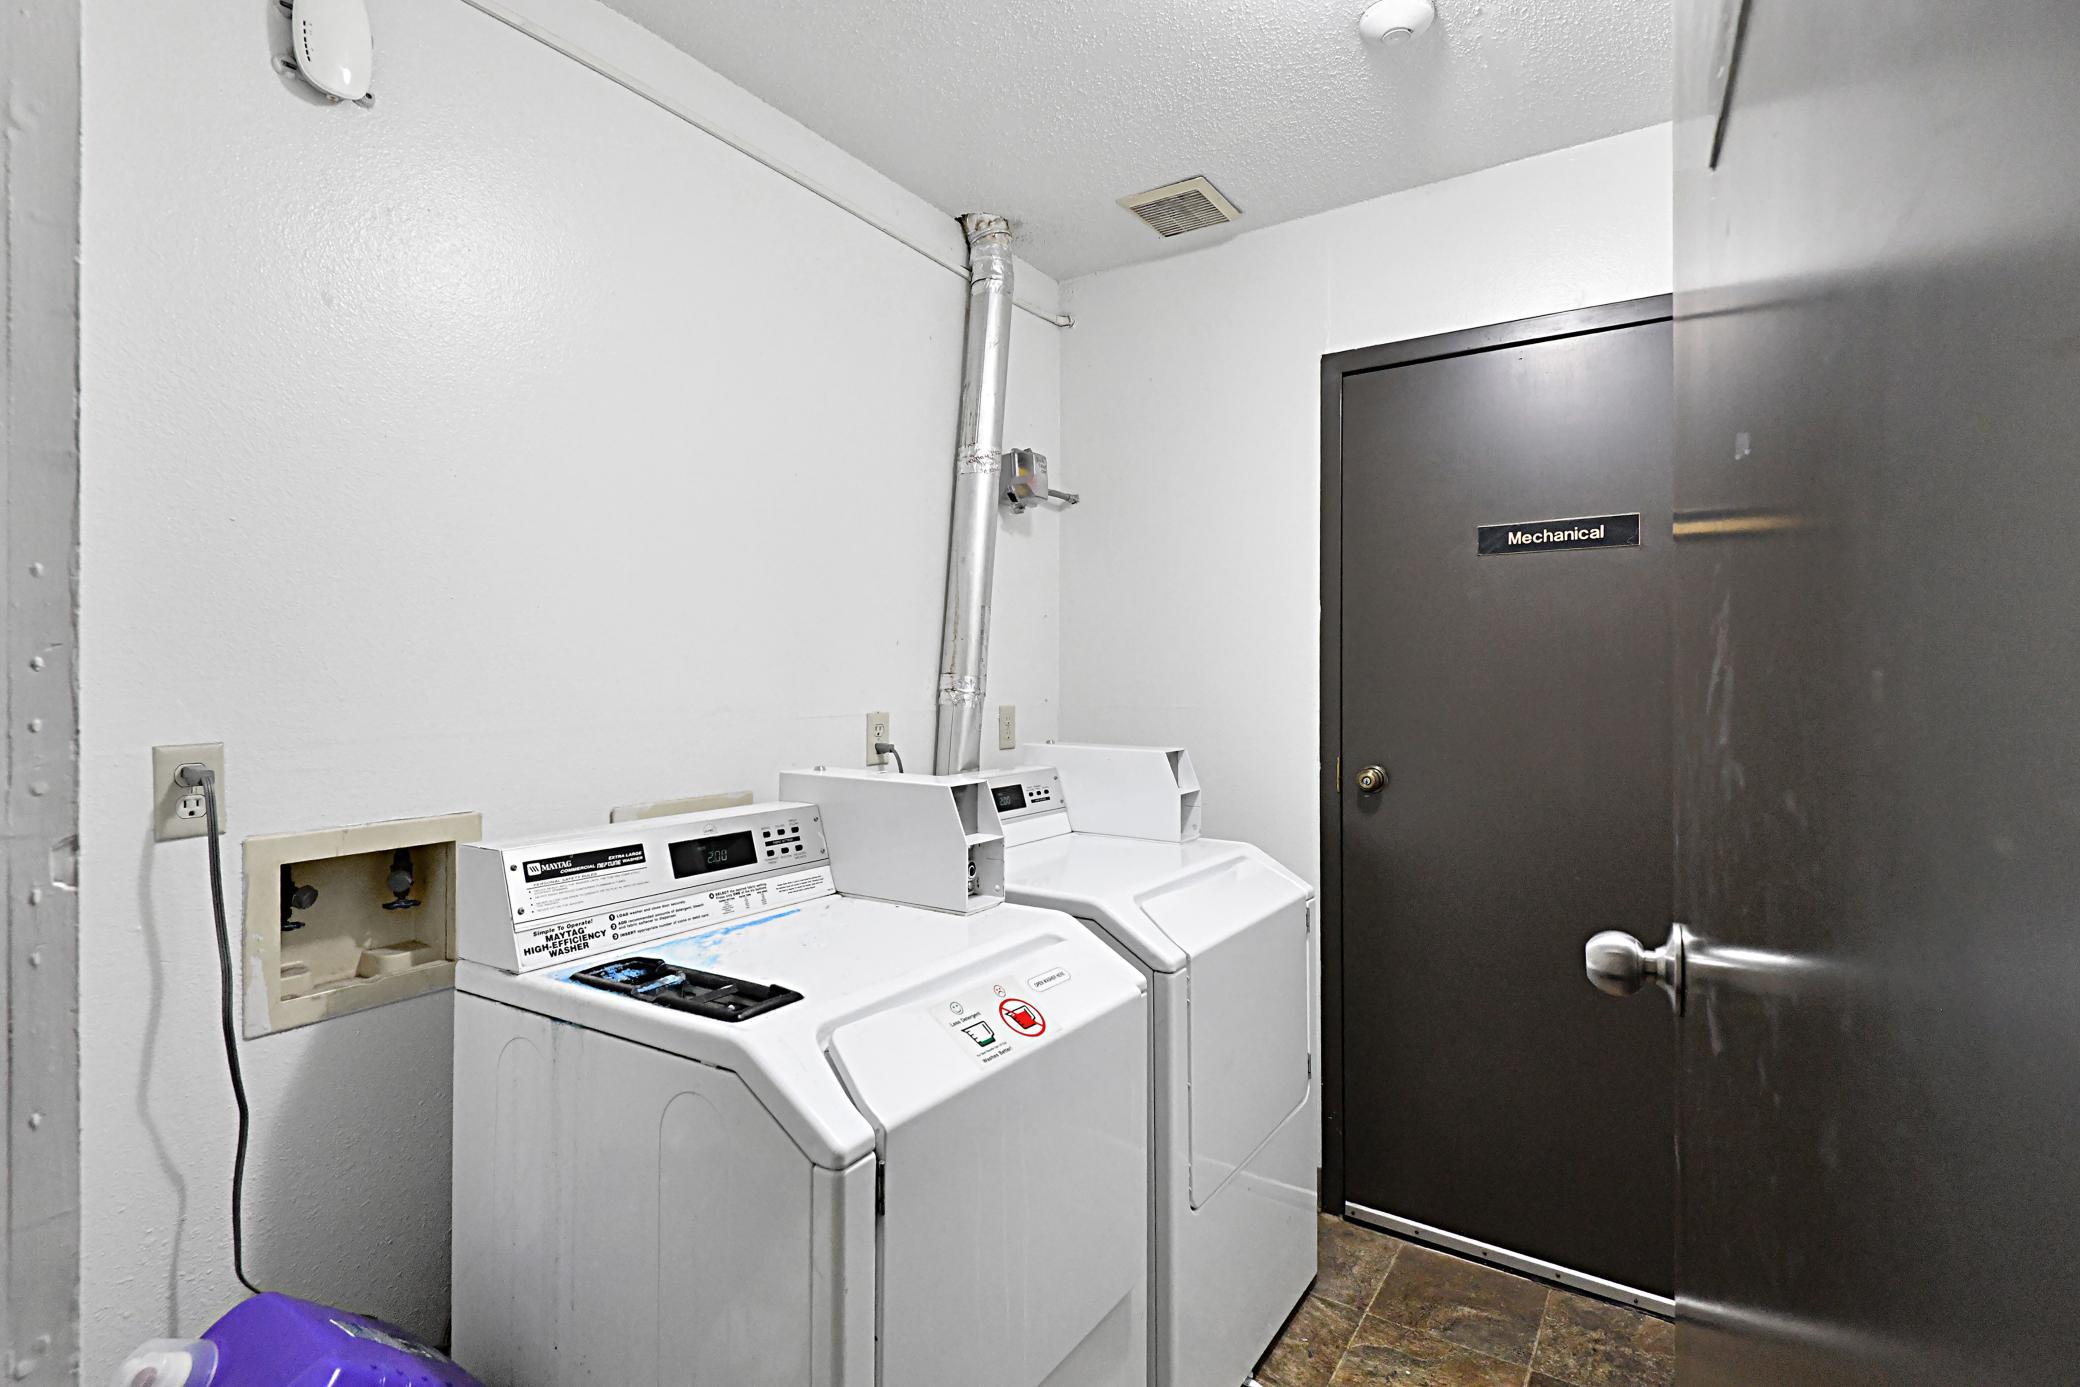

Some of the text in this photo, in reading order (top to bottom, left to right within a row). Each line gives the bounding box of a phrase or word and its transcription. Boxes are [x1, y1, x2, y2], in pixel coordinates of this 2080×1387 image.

[1508, 524, 1605, 545] Mechanical
[608, 850, 643, 861] EXTRA LARGE
[541, 860, 572, 872] MAYTAG
[560, 864, 595, 874] COMMERCIAL
[622, 855, 644, 864] WASHER
[533, 928, 556, 938] Simple
[566, 918, 594, 929] Operate!
[545, 927, 585, 943] MAYTAG
[523, 929, 607, 956] HIGH-EFFICIENCY
[548, 942, 590, 958] WASHER
[960, 1011, 982, 1023] Detergent
[982, 1053, 1000, 1063] Washes
